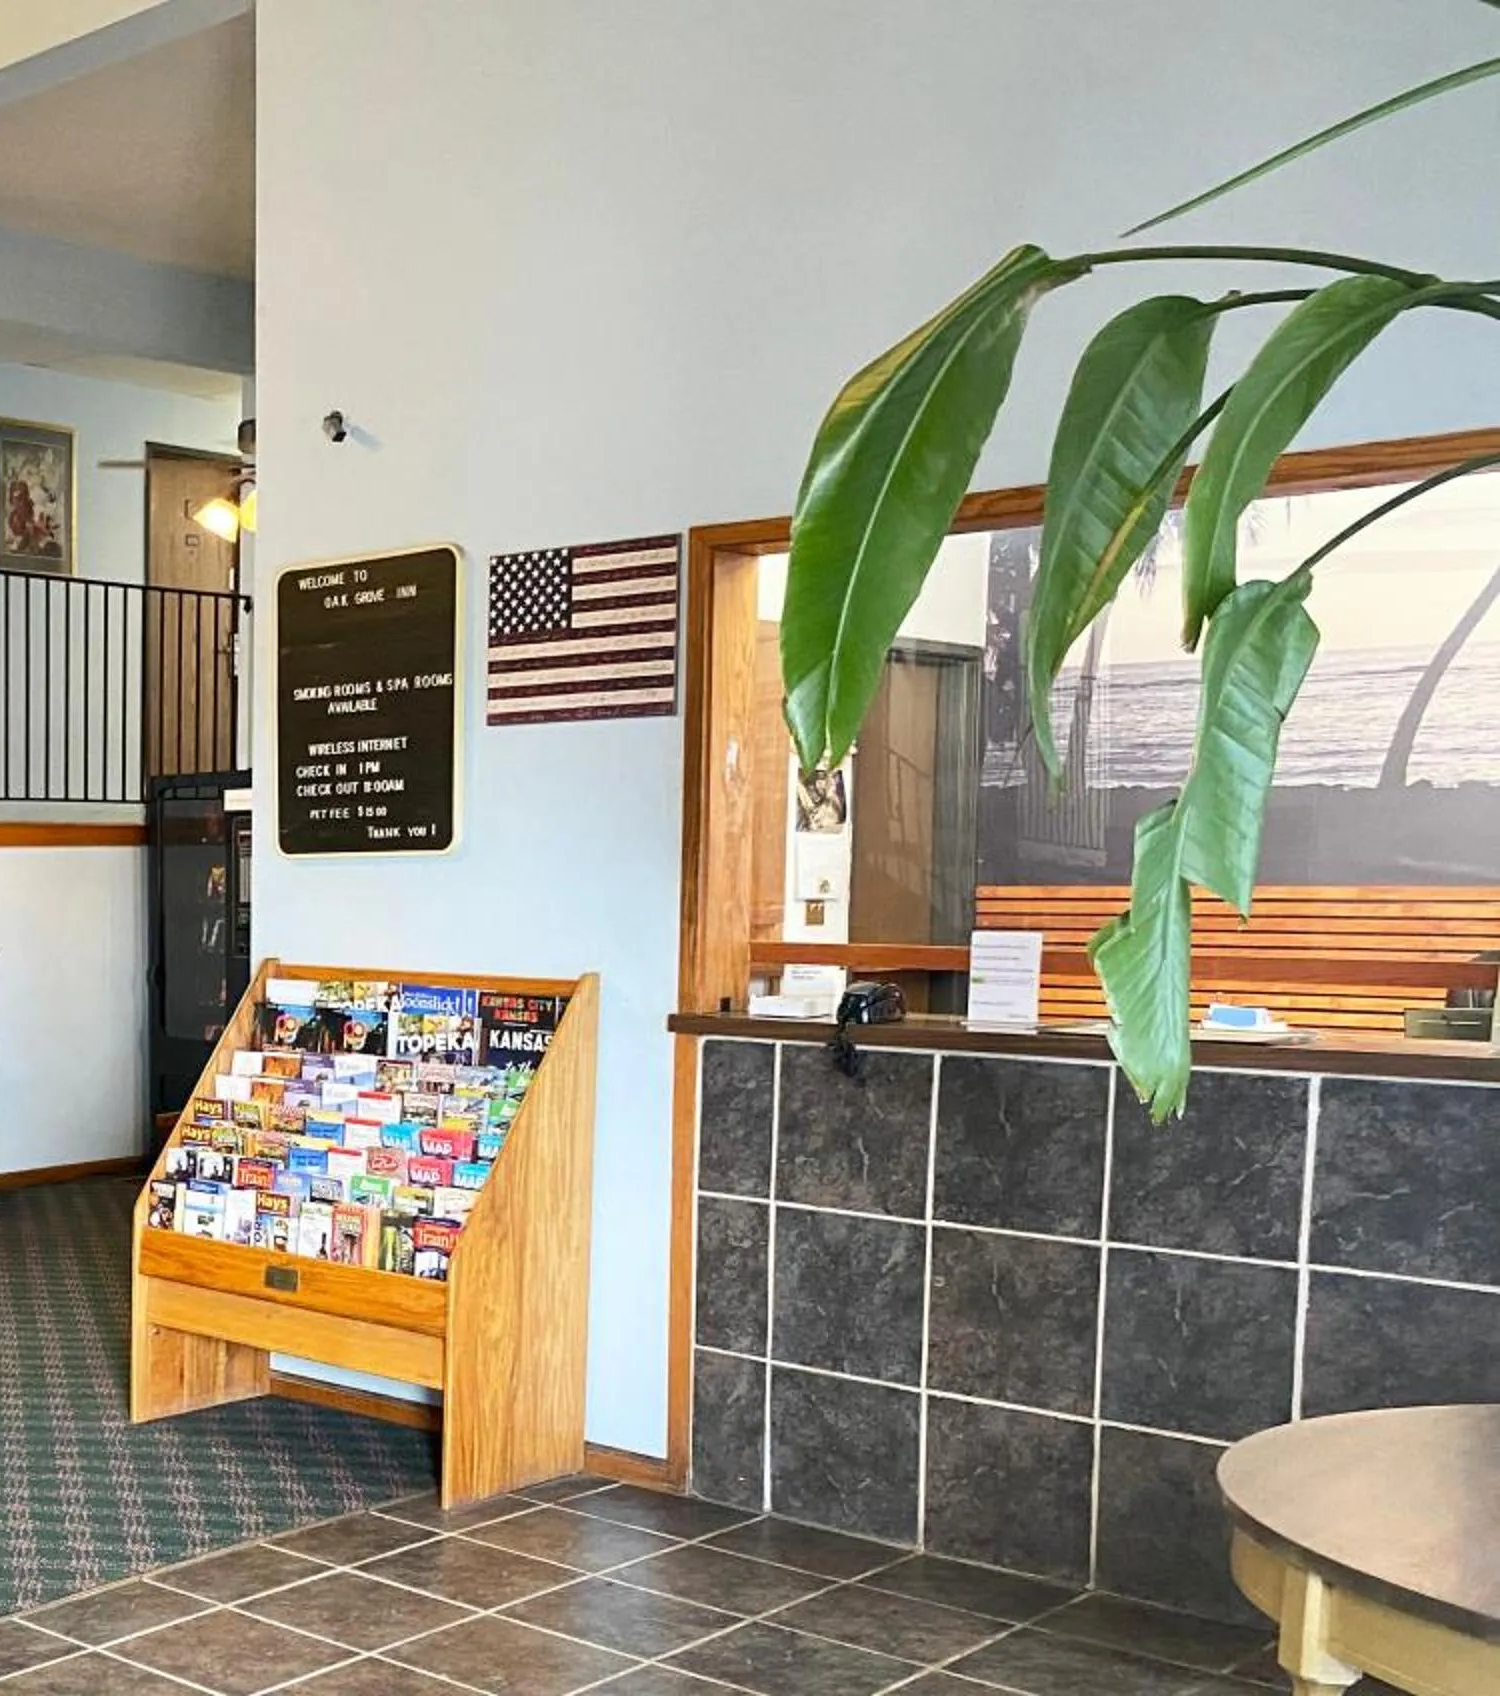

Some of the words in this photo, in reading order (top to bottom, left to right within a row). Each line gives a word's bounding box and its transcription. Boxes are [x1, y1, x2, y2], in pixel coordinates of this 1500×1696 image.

[297, 572, 345, 591] WELCOME
[353, 569, 368, 583] TO
[323, 593, 349, 609] OAK
[355, 588, 385, 605] GROVE
[395, 584, 417, 599] INN
[293, 685, 332, 701] SMOKING
[333, 681, 371, 697] ROOMS
[375, 679, 384, 694] &
[386, 676, 410, 692] SPA
[413, 673, 453, 689] ROOMS
[327, 697, 379, 715] AVAILABLE
[307, 740, 356, 757] WIRELESS
[357, 735, 409, 754] INTERNET
[295, 763, 331, 779] CHECK
[335, 762, 348, 776] IN
[295, 782, 332, 797] CHECK
[335, 780, 360, 795] OUT
[328, 807, 351, 820] FEE
[397, 1031, 476, 1053] TOPEKA
[421, 1140, 453, 1155] MAP
[410, 1168, 441, 1183] MAP
[257, 1193, 288, 1210] Hays
